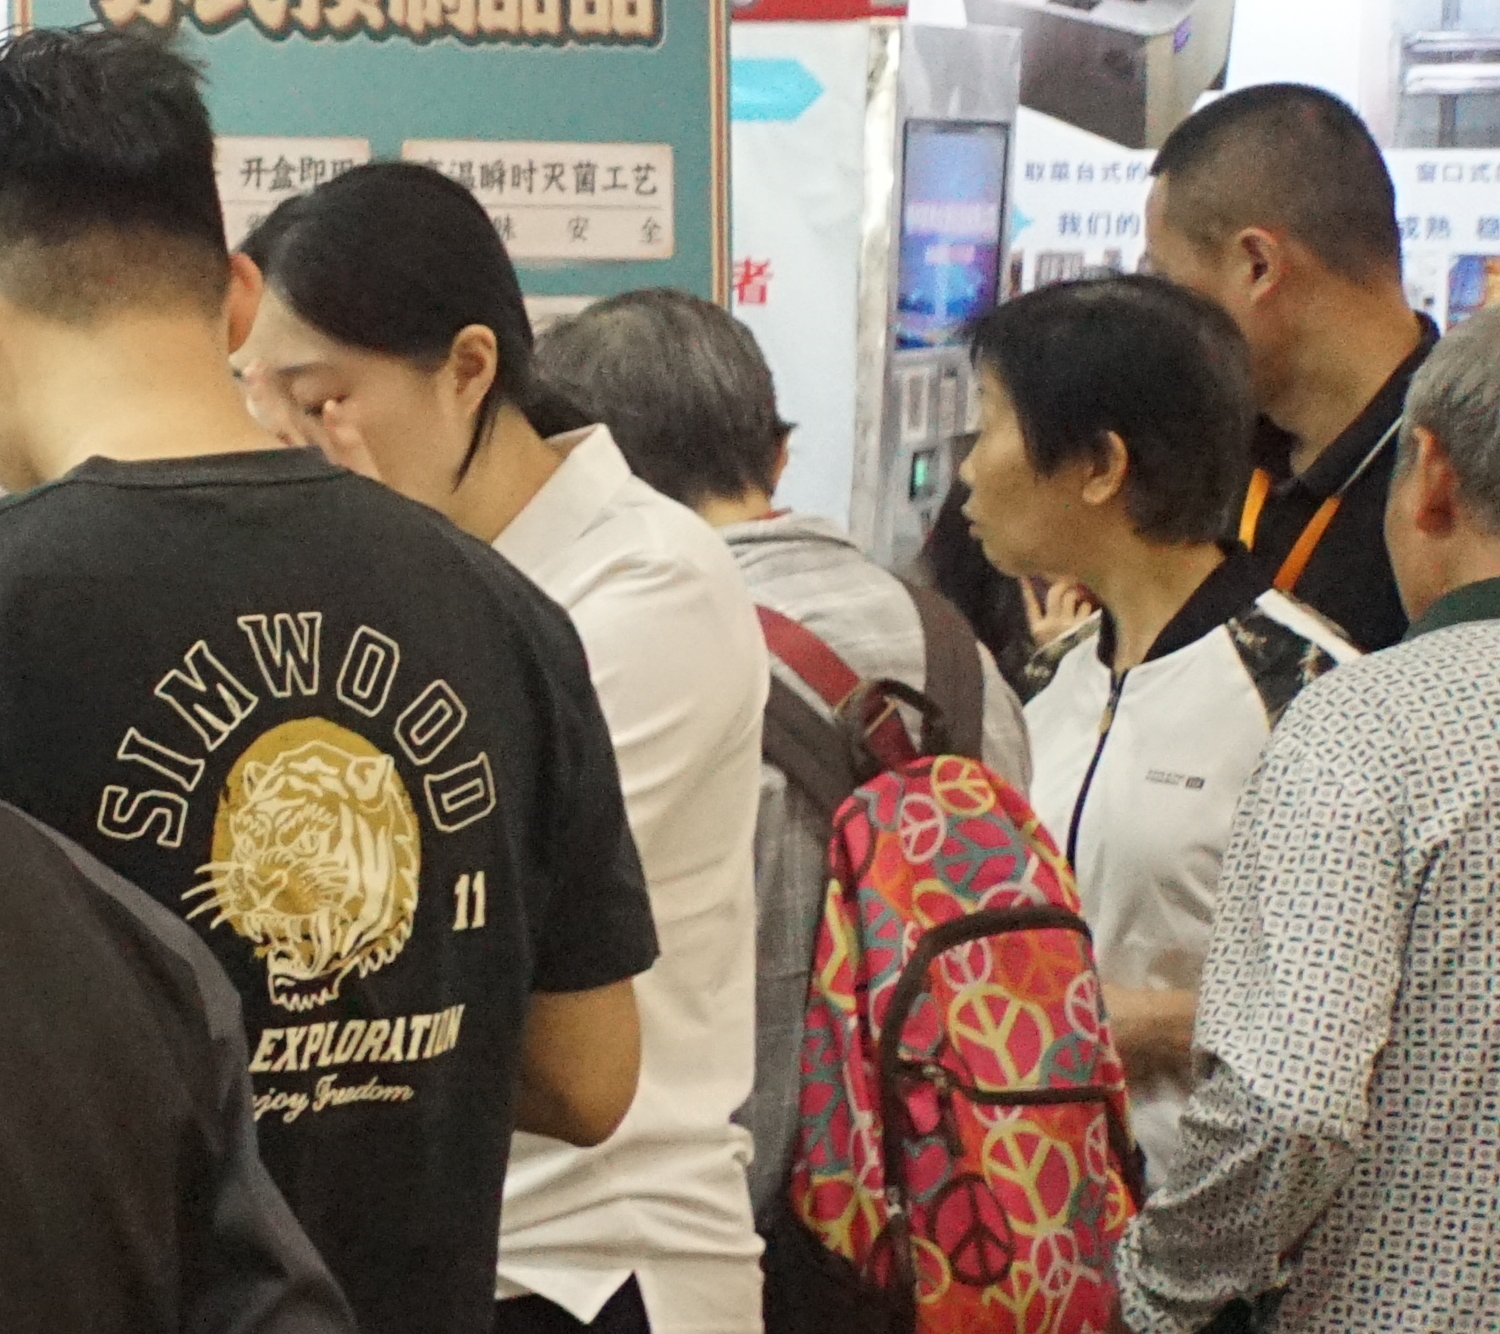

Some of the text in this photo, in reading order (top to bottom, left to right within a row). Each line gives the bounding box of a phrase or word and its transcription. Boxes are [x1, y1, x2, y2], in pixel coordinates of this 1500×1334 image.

[1057, 211, 1141, 237] 我们的
[97, 610, 497, 847] SIMWOOD
[451, 870, 486, 931] 11
[247, 1003, 467, 1073] EXPLORATION
